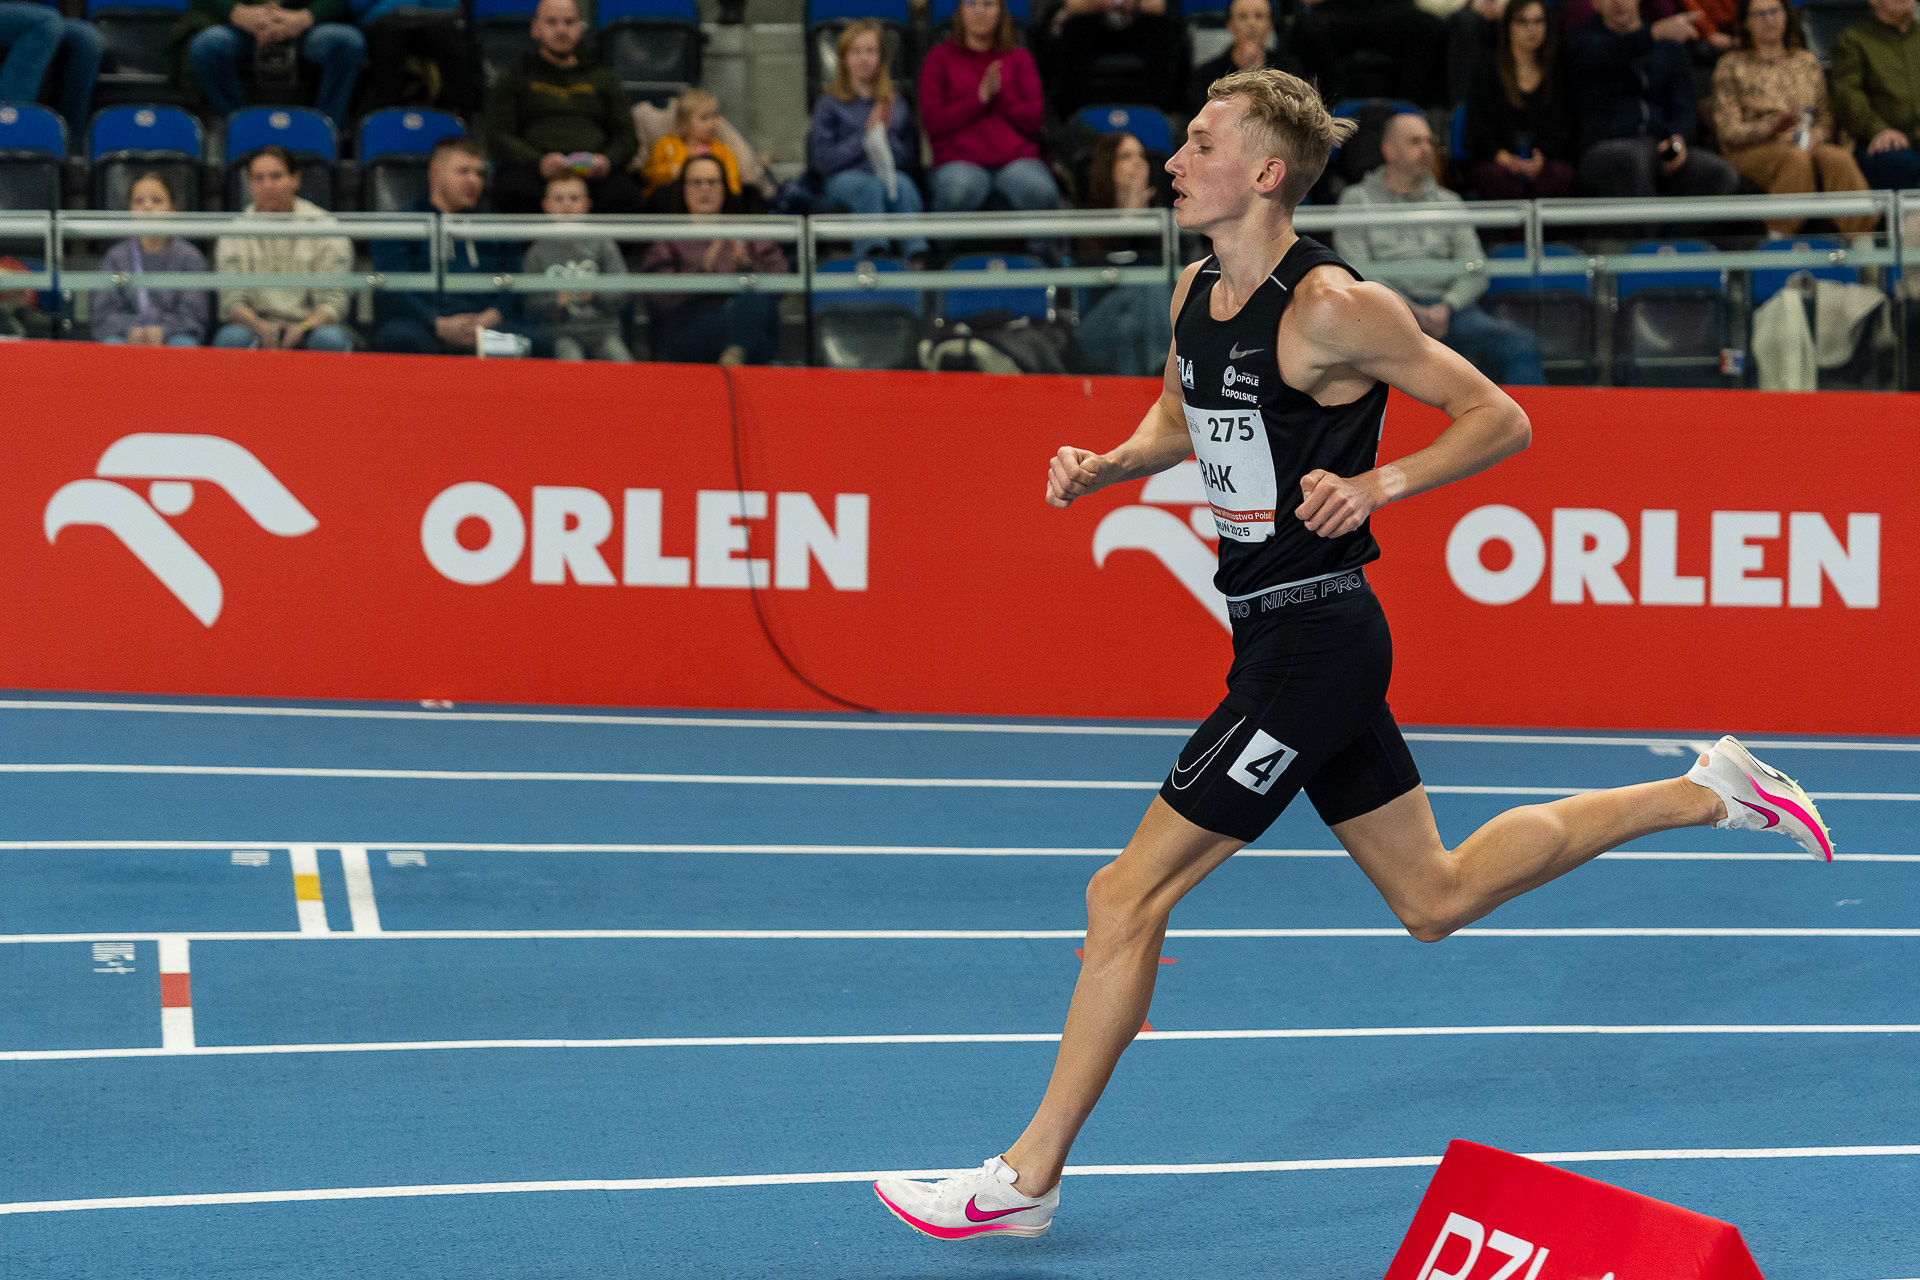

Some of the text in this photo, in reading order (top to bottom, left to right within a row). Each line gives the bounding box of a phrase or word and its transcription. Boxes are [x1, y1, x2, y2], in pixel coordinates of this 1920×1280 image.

[1236, 374, 1260, 387] OPOLE
[1207, 416, 1255, 443] 275
[420, 481, 869, 591] ORLEN
[1445, 503, 1881, 609] ORLEN
[1261, 583, 1318, 613] NIKE
[1321, 573, 1362, 598] PRO
[1244, 748, 1287, 788] 4
